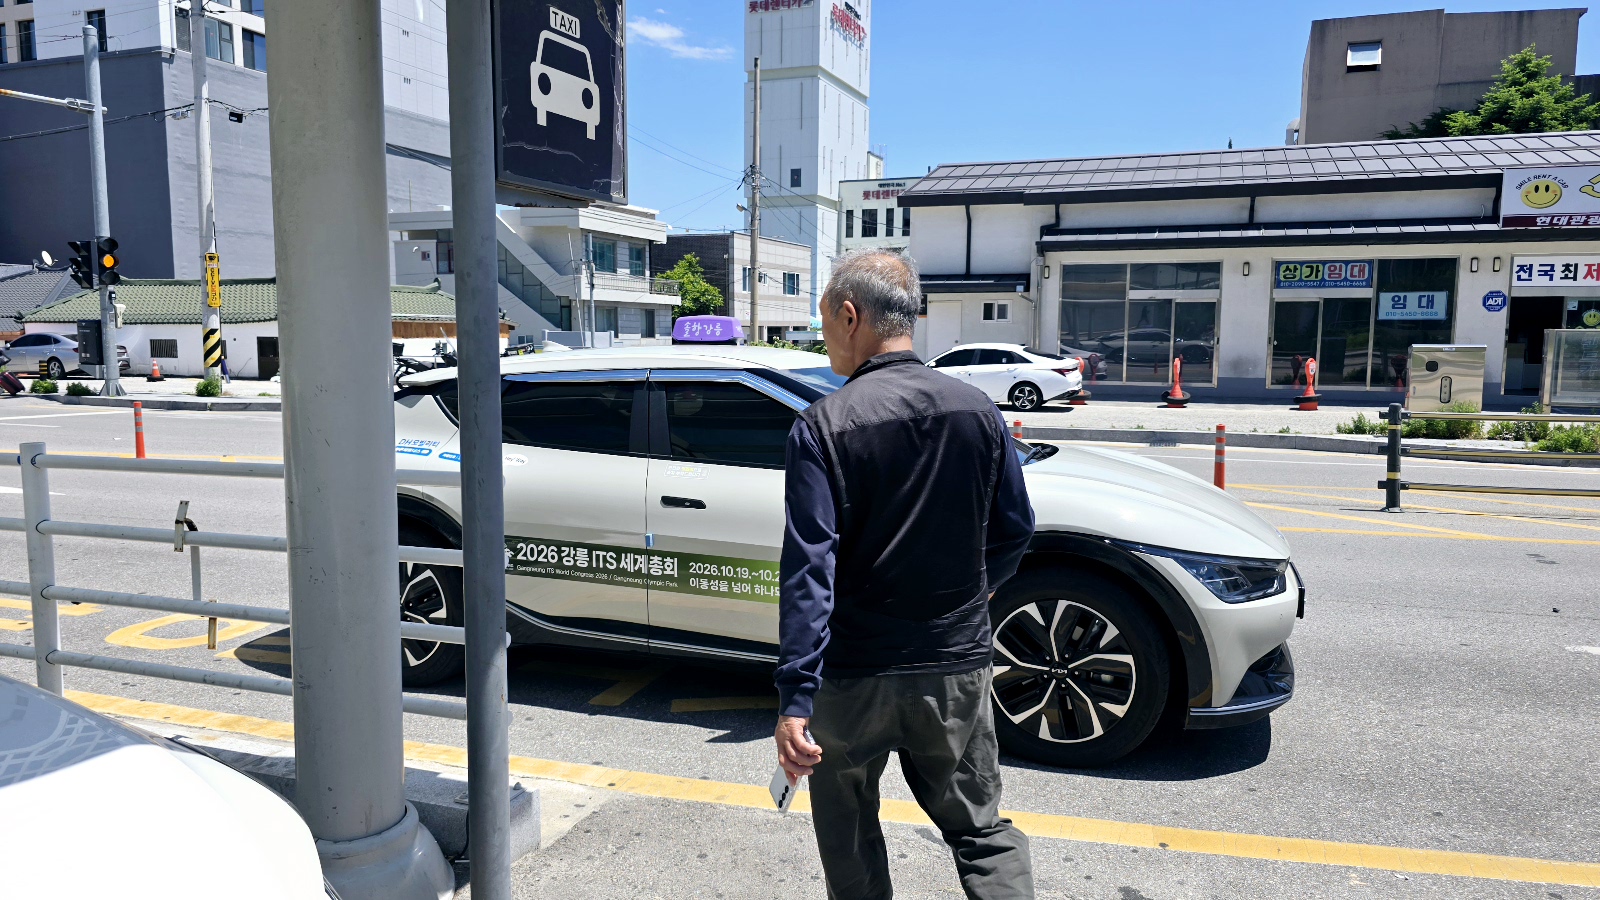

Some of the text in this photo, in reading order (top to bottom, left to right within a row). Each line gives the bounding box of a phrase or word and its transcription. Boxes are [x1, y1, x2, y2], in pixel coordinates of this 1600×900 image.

[551, 10, 577, 36] TAXI
[1515, 176, 1533, 191] SMILE
[1557, 178, 1569, 190] CAR
[862, 189, 905, 200] 롯데렌터
[1485, 297, 1504, 306] ADT
[516, 543, 679, 578] 2026 강릉 ITS 세계총회
[516, 564, 546, 575] Gangneung
[546, 567, 555, 575] ITS
[555, 568, 570, 576] World
[570, 569, 595, 579] Congress
[643, 577, 665, 587] Olympic
[689, 577, 729, 592] 이동성을
[731, 581, 752, 595] 넘어
